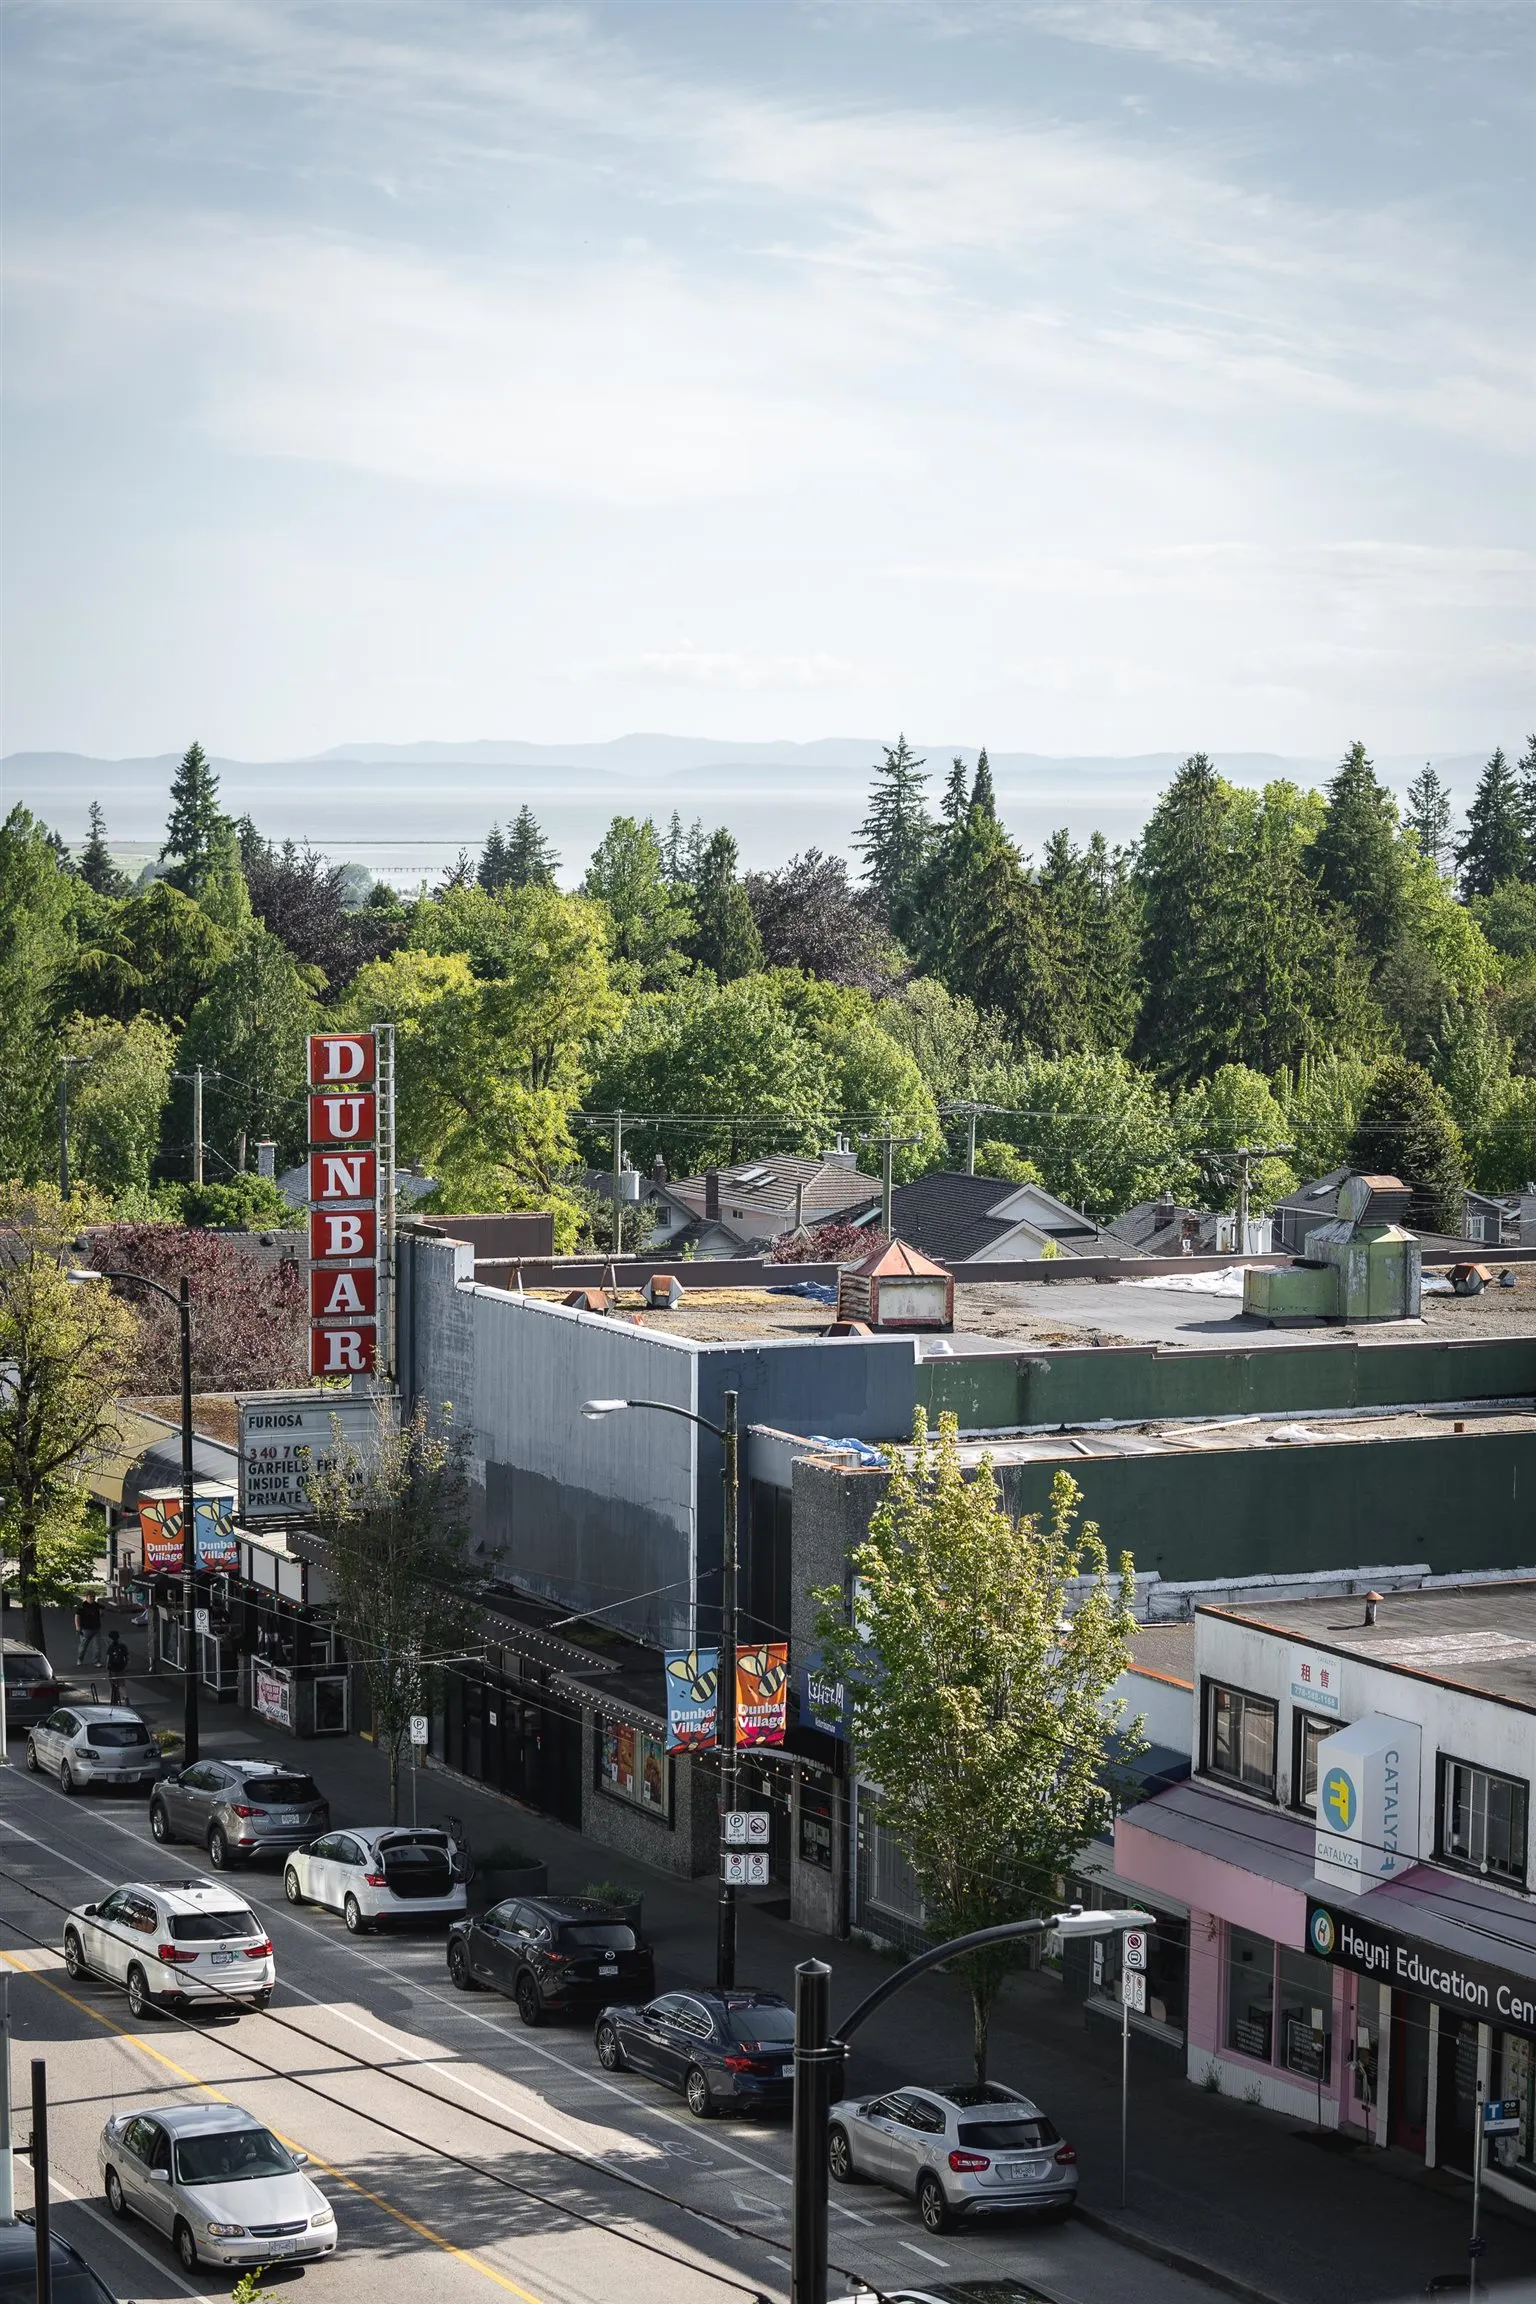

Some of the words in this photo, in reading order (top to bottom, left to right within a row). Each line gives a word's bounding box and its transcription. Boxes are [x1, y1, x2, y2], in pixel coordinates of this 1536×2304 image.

[323, 1040, 367, 1371] DUNBAR
[248, 1414, 303, 1429] FURIOSA
[248, 1476, 290, 1490] INSIDE
[248, 1490, 302, 1505] PRIVATE
[147, 1542, 184, 1552] Dunbar
[148, 1552, 183, 1562] Village
[200, 1551, 238, 1561] Village
[671, 1708, 716, 1721] Dunbar
[738, 1702, 784, 1715] Dunbar
[672, 1721, 715, 1734] Village
[738, 1716, 783, 1728] Village
[1341, 1924, 1389, 1970] Heyni
[1396, 1946, 1489, 2008] Education
[1496, 1985, 1536, 2025] Cen
